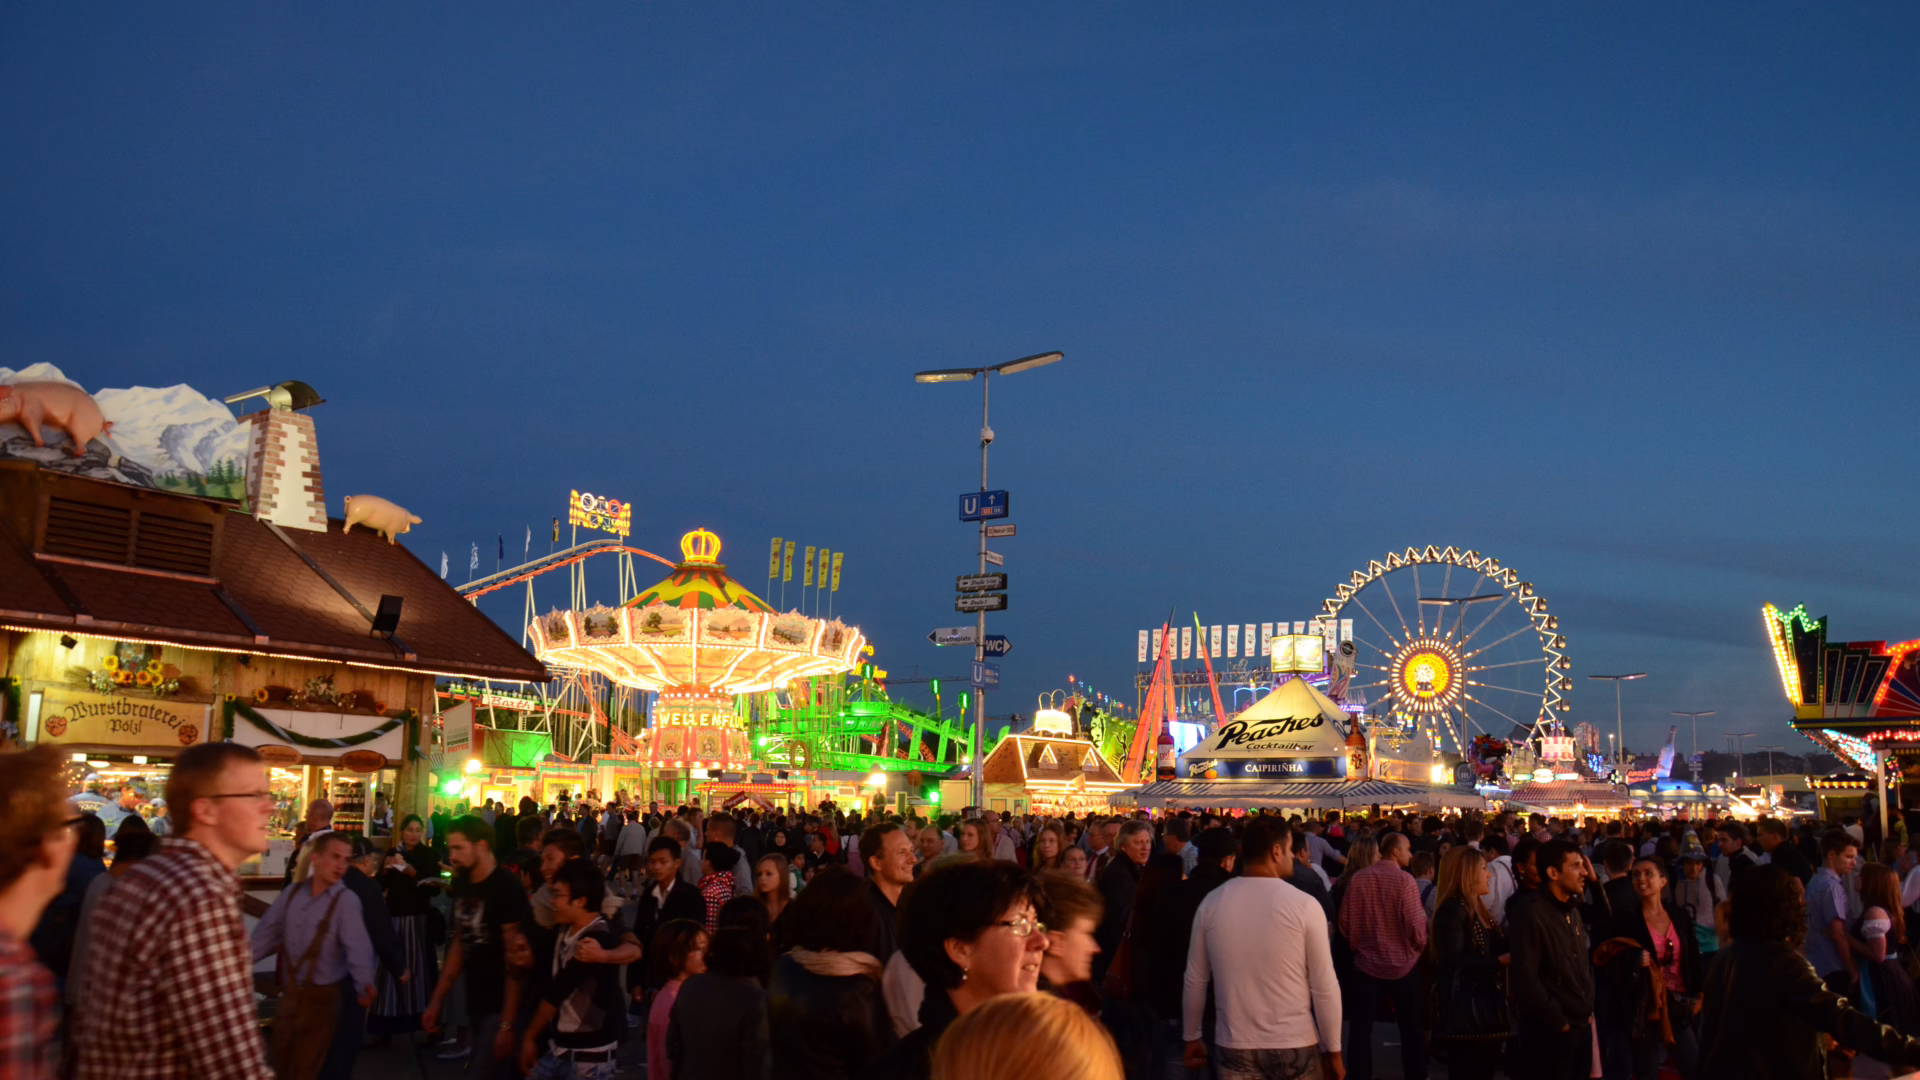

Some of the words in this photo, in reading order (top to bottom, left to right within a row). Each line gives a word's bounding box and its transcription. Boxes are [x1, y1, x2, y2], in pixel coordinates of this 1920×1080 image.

[965, 498, 976, 514] U
[985, 640, 1003, 652] WC
[973, 665, 983, 682] U
[65, 698, 186, 730] Wurstbraterei
[1215, 713, 1324, 750] Peaches
[1246, 741, 1314, 751] Cocktailbar
